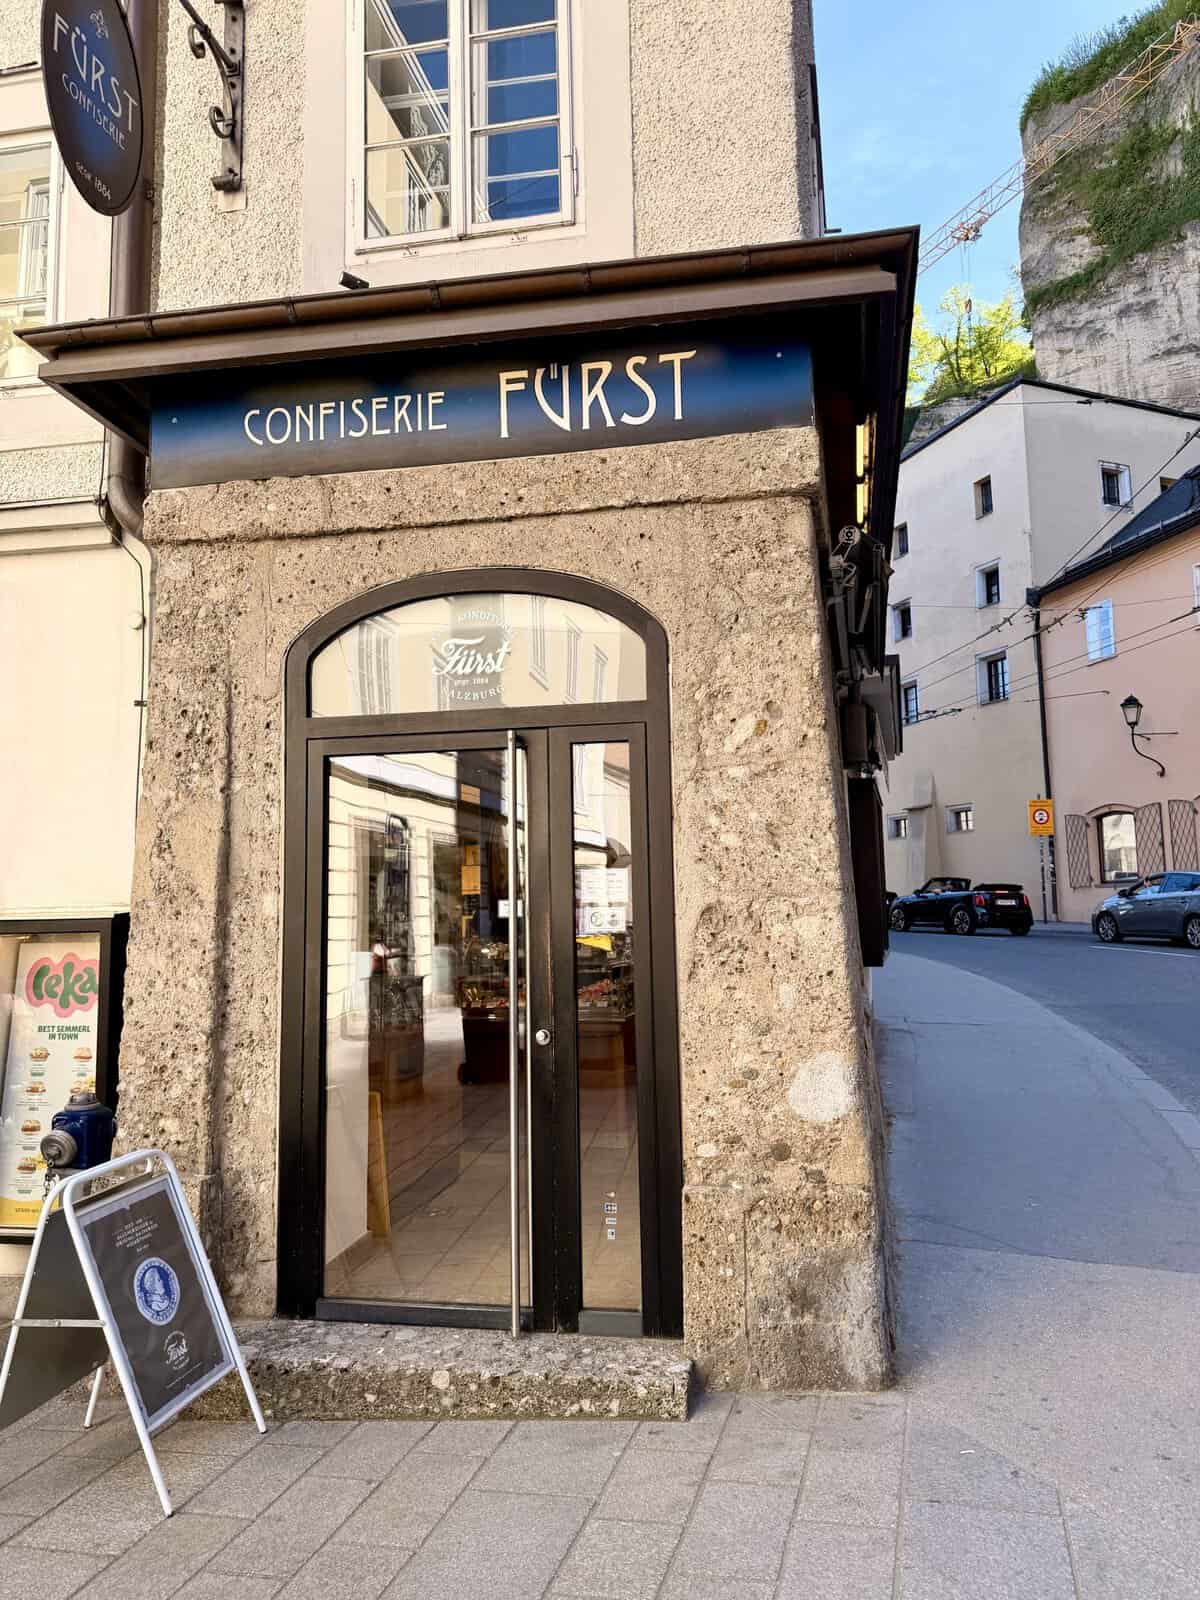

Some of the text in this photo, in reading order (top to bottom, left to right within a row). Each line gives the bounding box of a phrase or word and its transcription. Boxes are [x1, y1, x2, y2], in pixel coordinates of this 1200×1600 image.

[53, 12, 138, 132] FÜRST
[62, 73, 126, 151] CONFISERIE
[244, 350, 697, 446] CONFISERIE FÜRST
[432, 635, 512, 675] Fürst
[48, 1033, 79, 1041] IN TOWN
